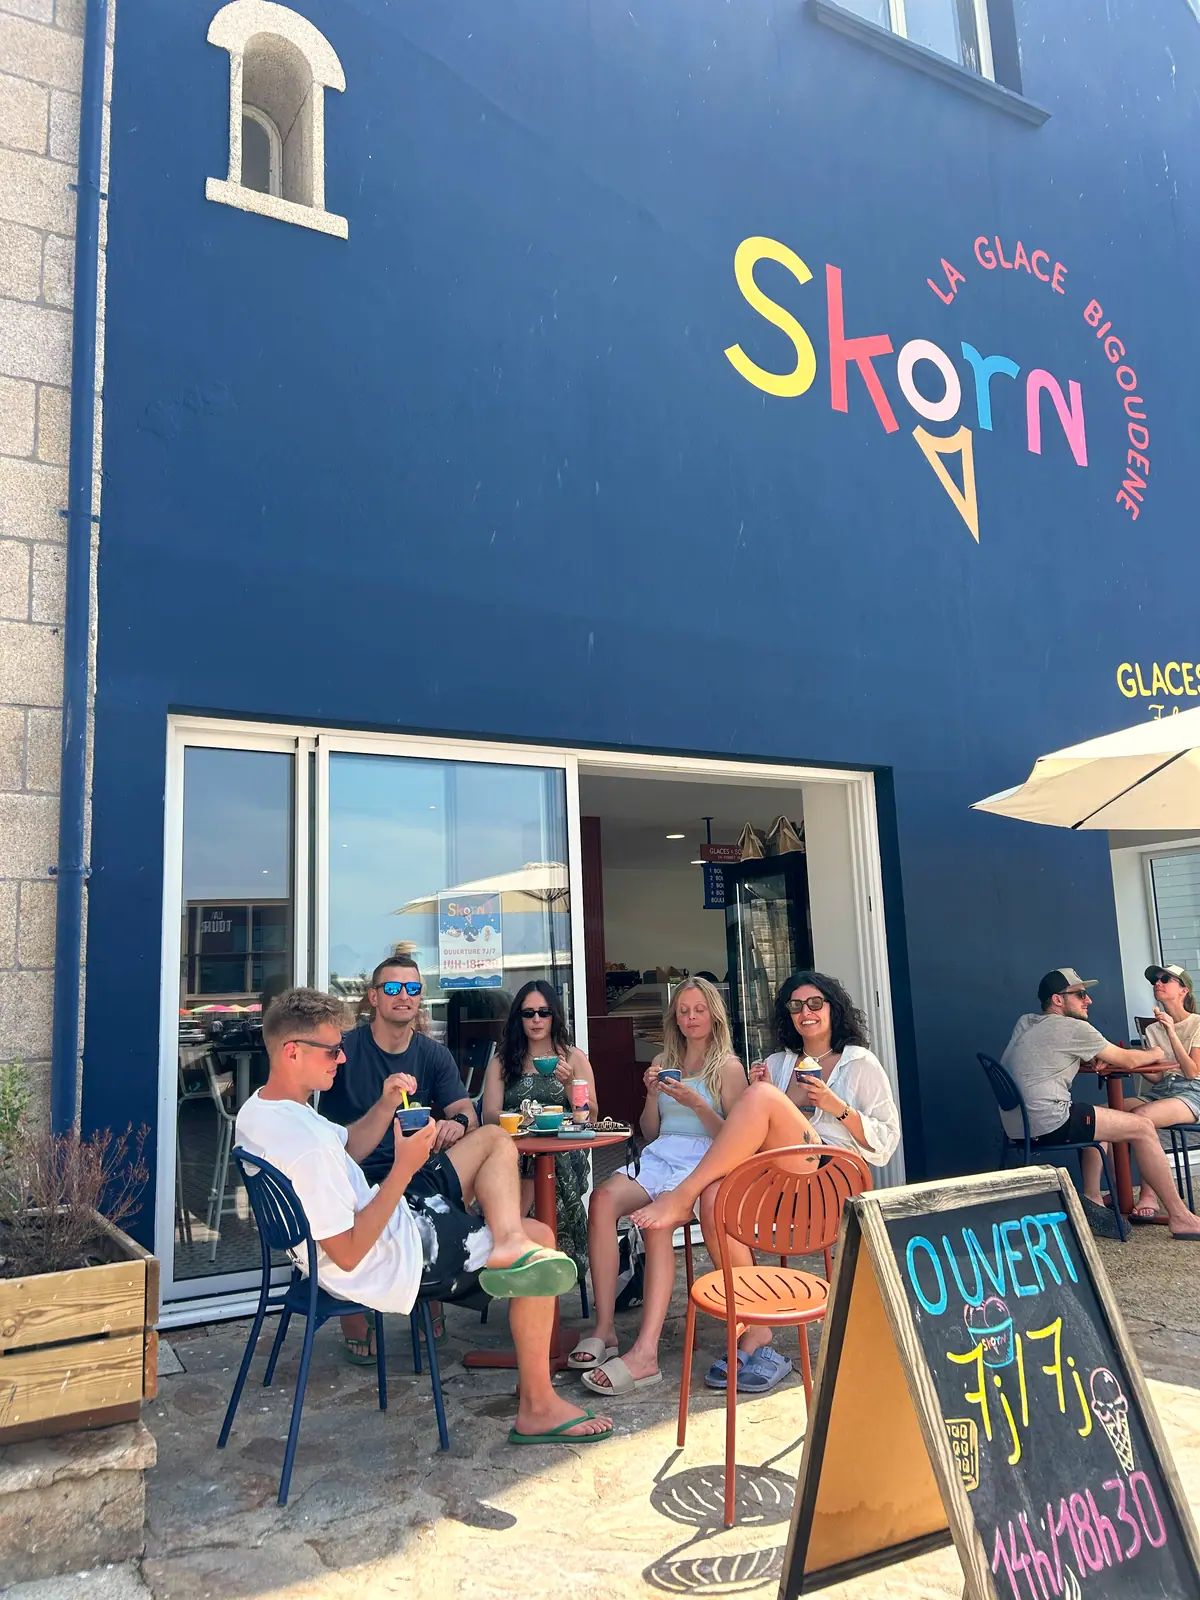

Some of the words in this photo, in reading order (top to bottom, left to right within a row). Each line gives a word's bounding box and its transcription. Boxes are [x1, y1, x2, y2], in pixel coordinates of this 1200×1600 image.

[926, 257, 966, 305] LA
[973, 235, 1068, 295] GLACE
[1083, 299, 1150, 521] BIGOUDENE
[905, 1211, 1078, 1316] OUVERT
